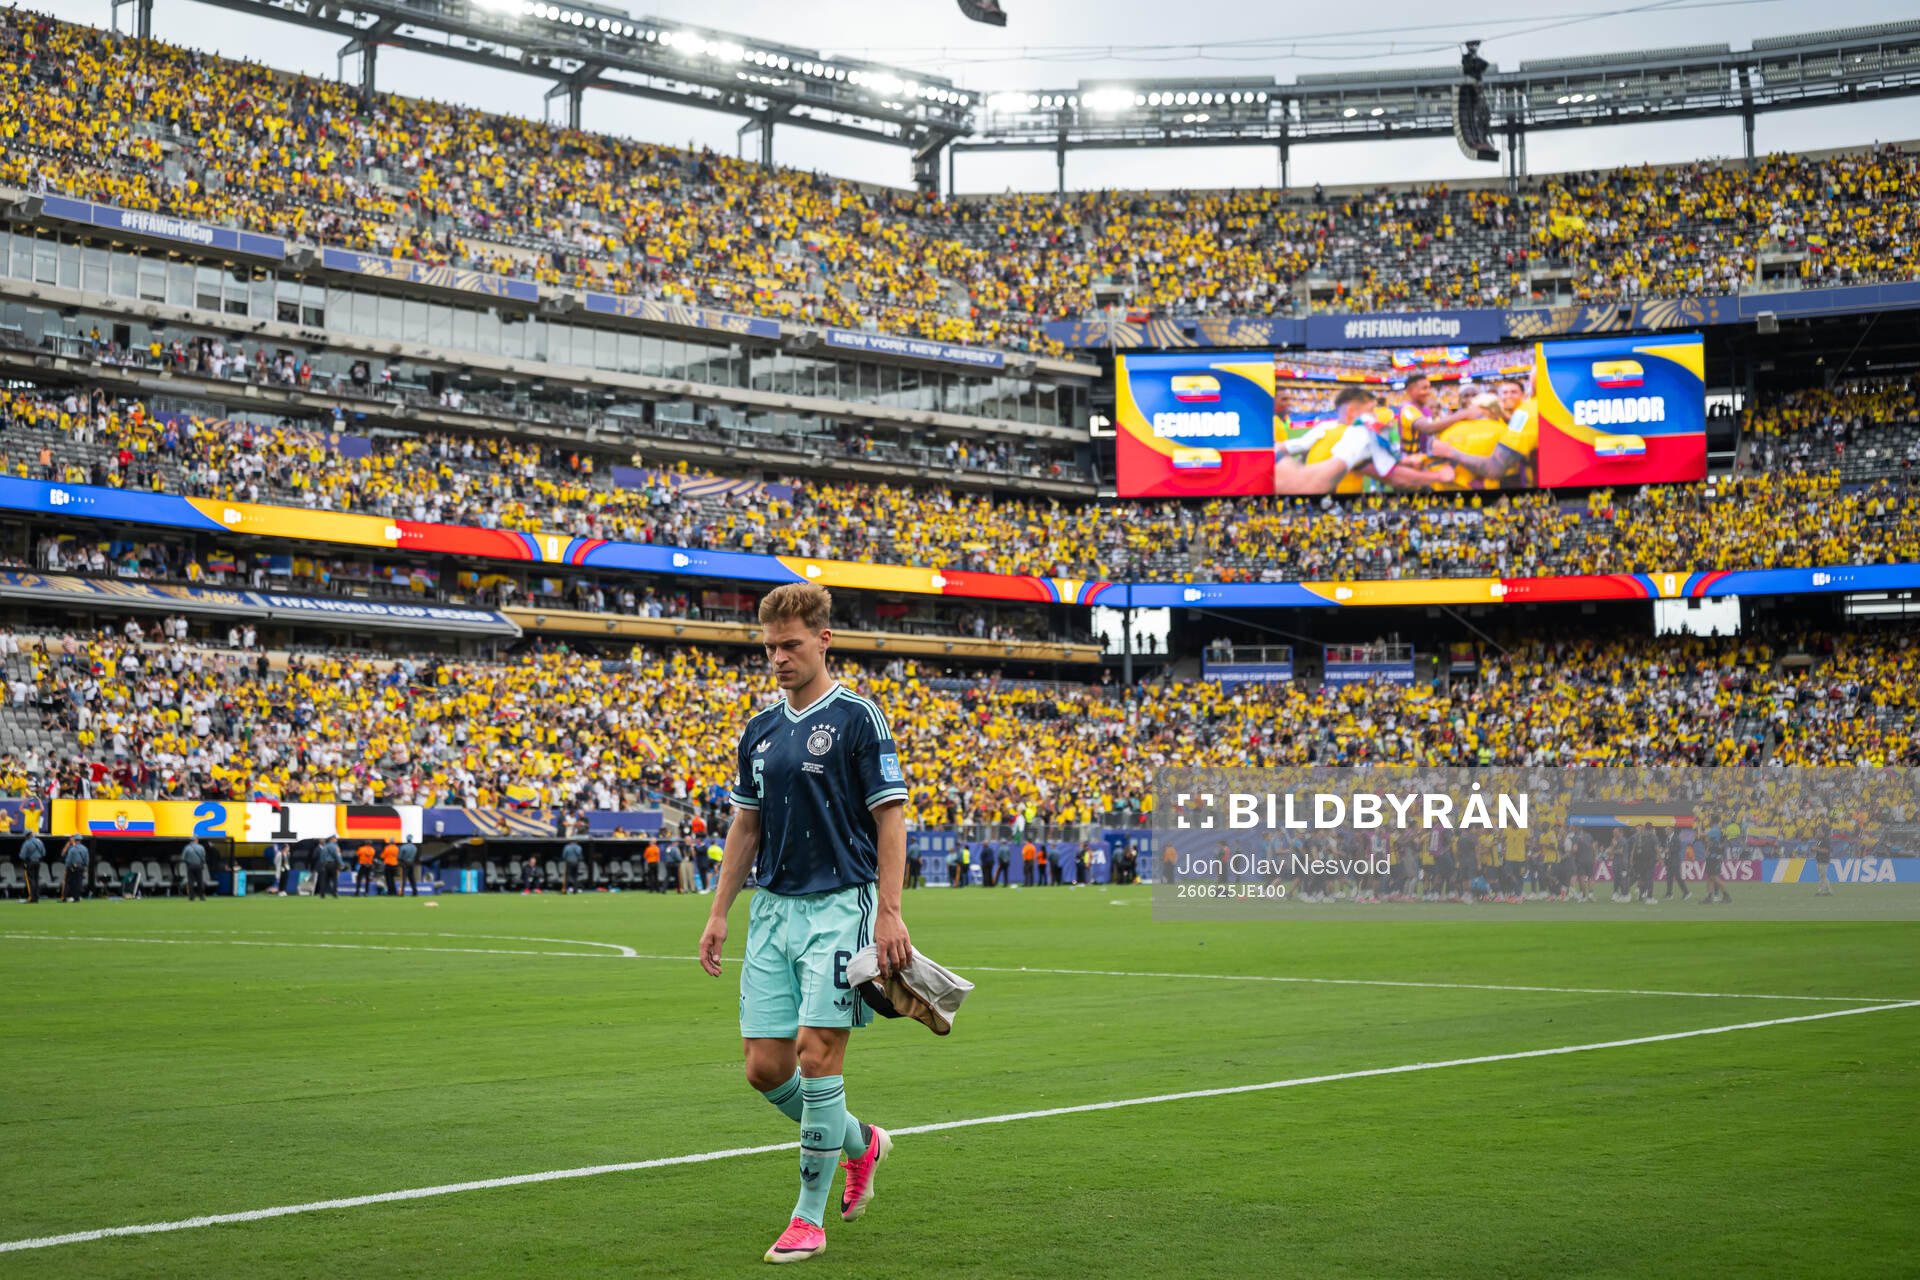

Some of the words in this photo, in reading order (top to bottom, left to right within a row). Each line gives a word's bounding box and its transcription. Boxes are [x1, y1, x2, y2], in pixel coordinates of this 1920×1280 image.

[121, 212, 214, 245] #FIFAWorldCup
[1344, 317, 1461, 338] #FIFAWorldCup
[834, 332, 867, 346] NEW
[869, 337, 908, 352] YORK
[909, 343, 942, 358] NEW
[943, 349, 997, 364] JERSEY
[1153, 411, 1240, 437] ECUADOR
[1574, 396, 1665, 425] ECUADOR
[268, 596, 318, 609] FIFA
[313, 600, 388, 614] WORLD
[388, 605, 426, 617] CUP
[193, 801, 227, 837] 2
[271, 806, 297, 839] 1
[1830, 856, 1897, 882] VISA
[834, 950, 852, 989] 6
